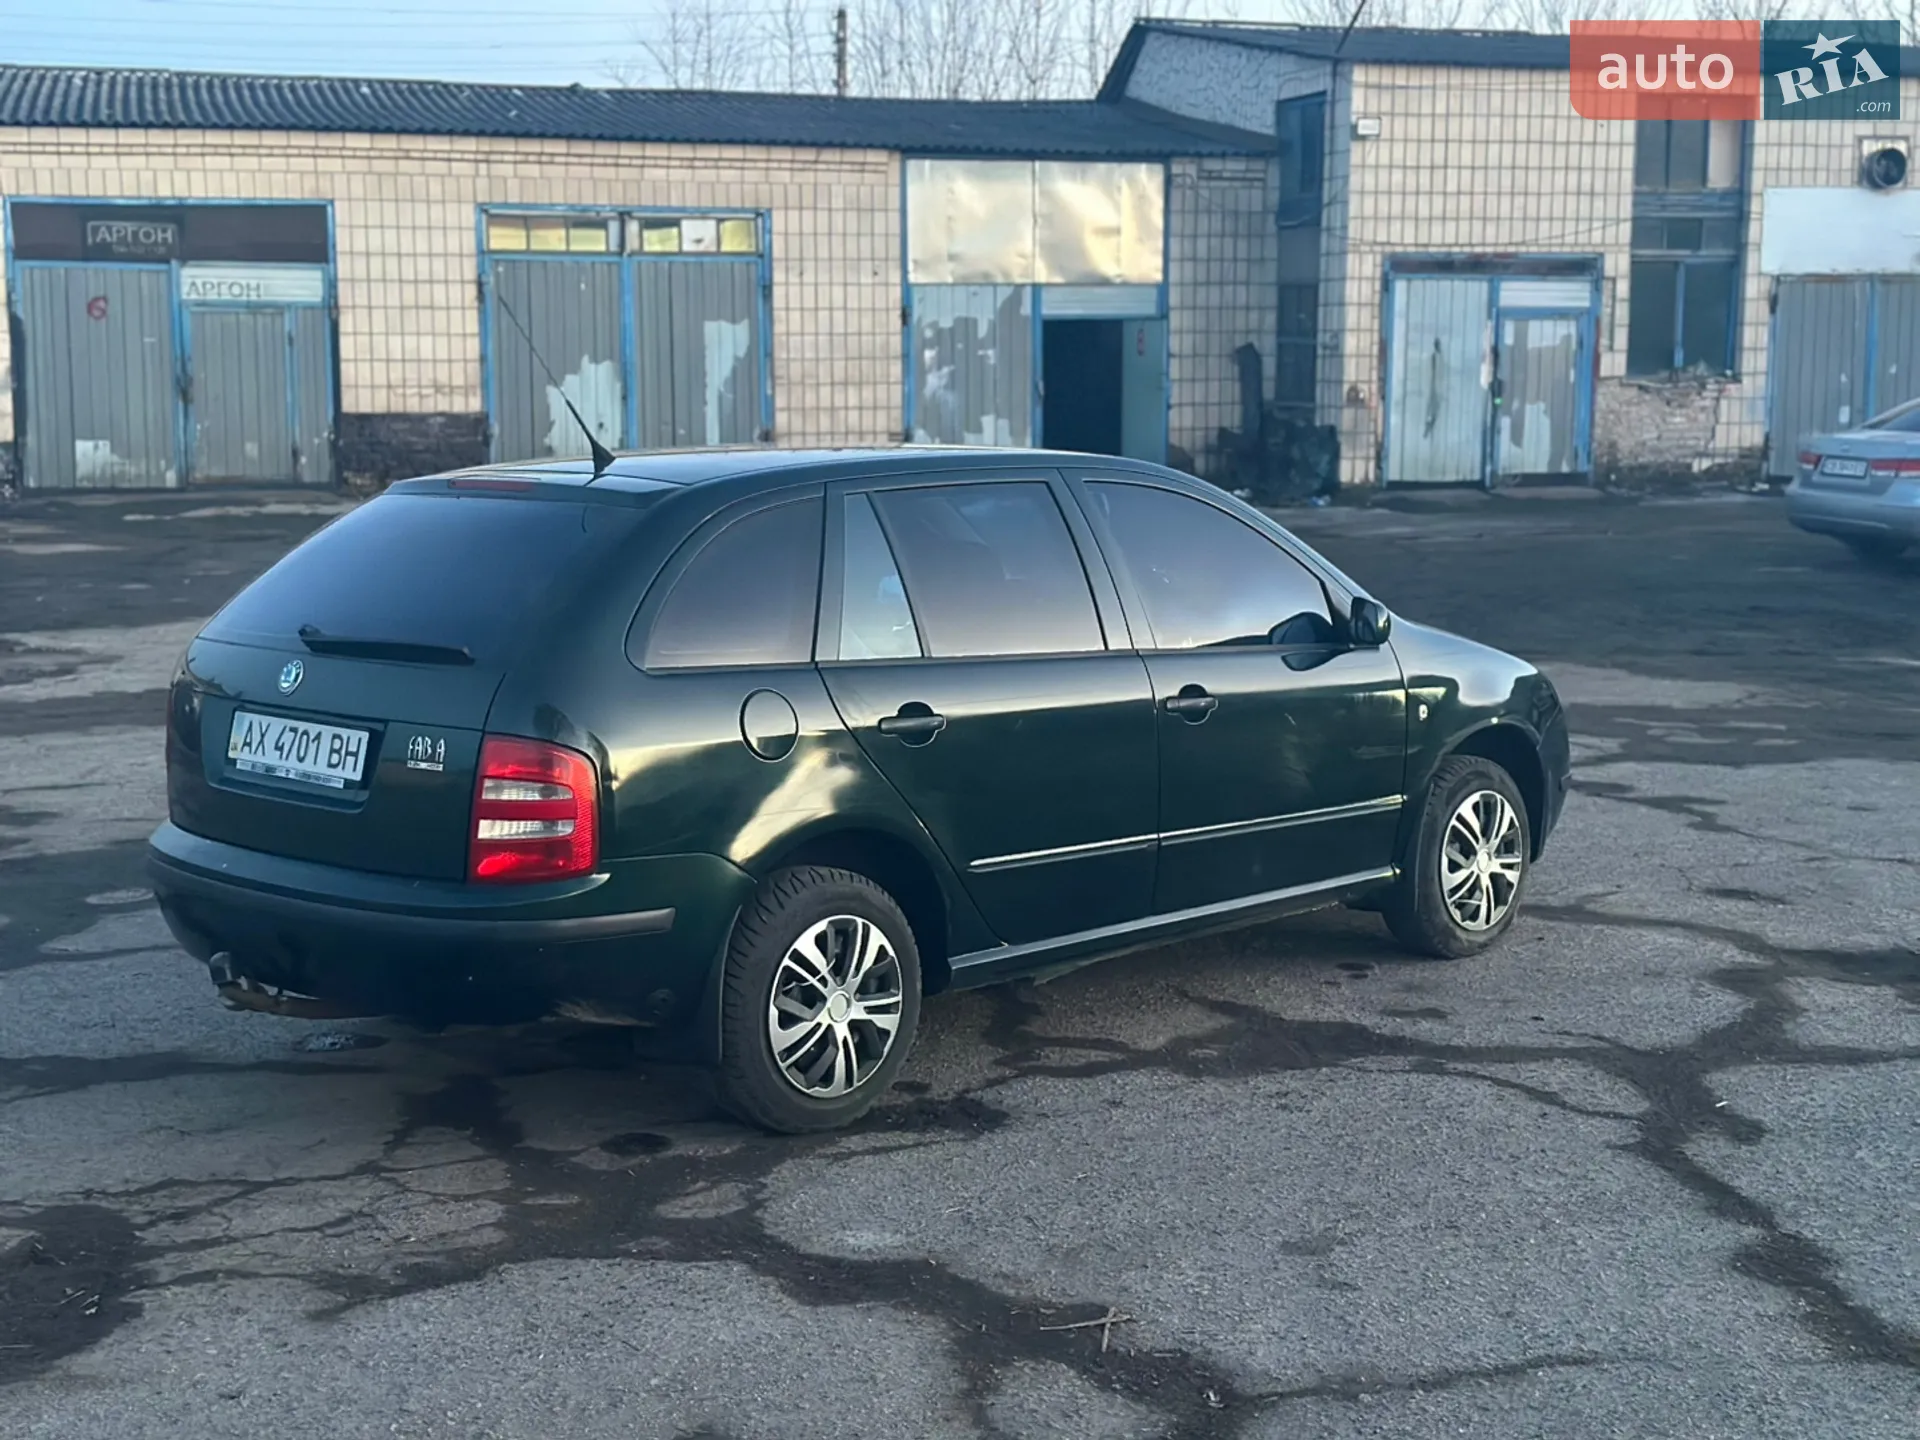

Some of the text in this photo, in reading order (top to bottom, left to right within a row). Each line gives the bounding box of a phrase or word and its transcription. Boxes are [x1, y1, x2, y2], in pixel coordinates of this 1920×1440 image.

[96, 225, 173, 243] АРГОН
[186, 279, 261, 298] АРГОН
[240, 720, 362, 772] AX 4701 BH
